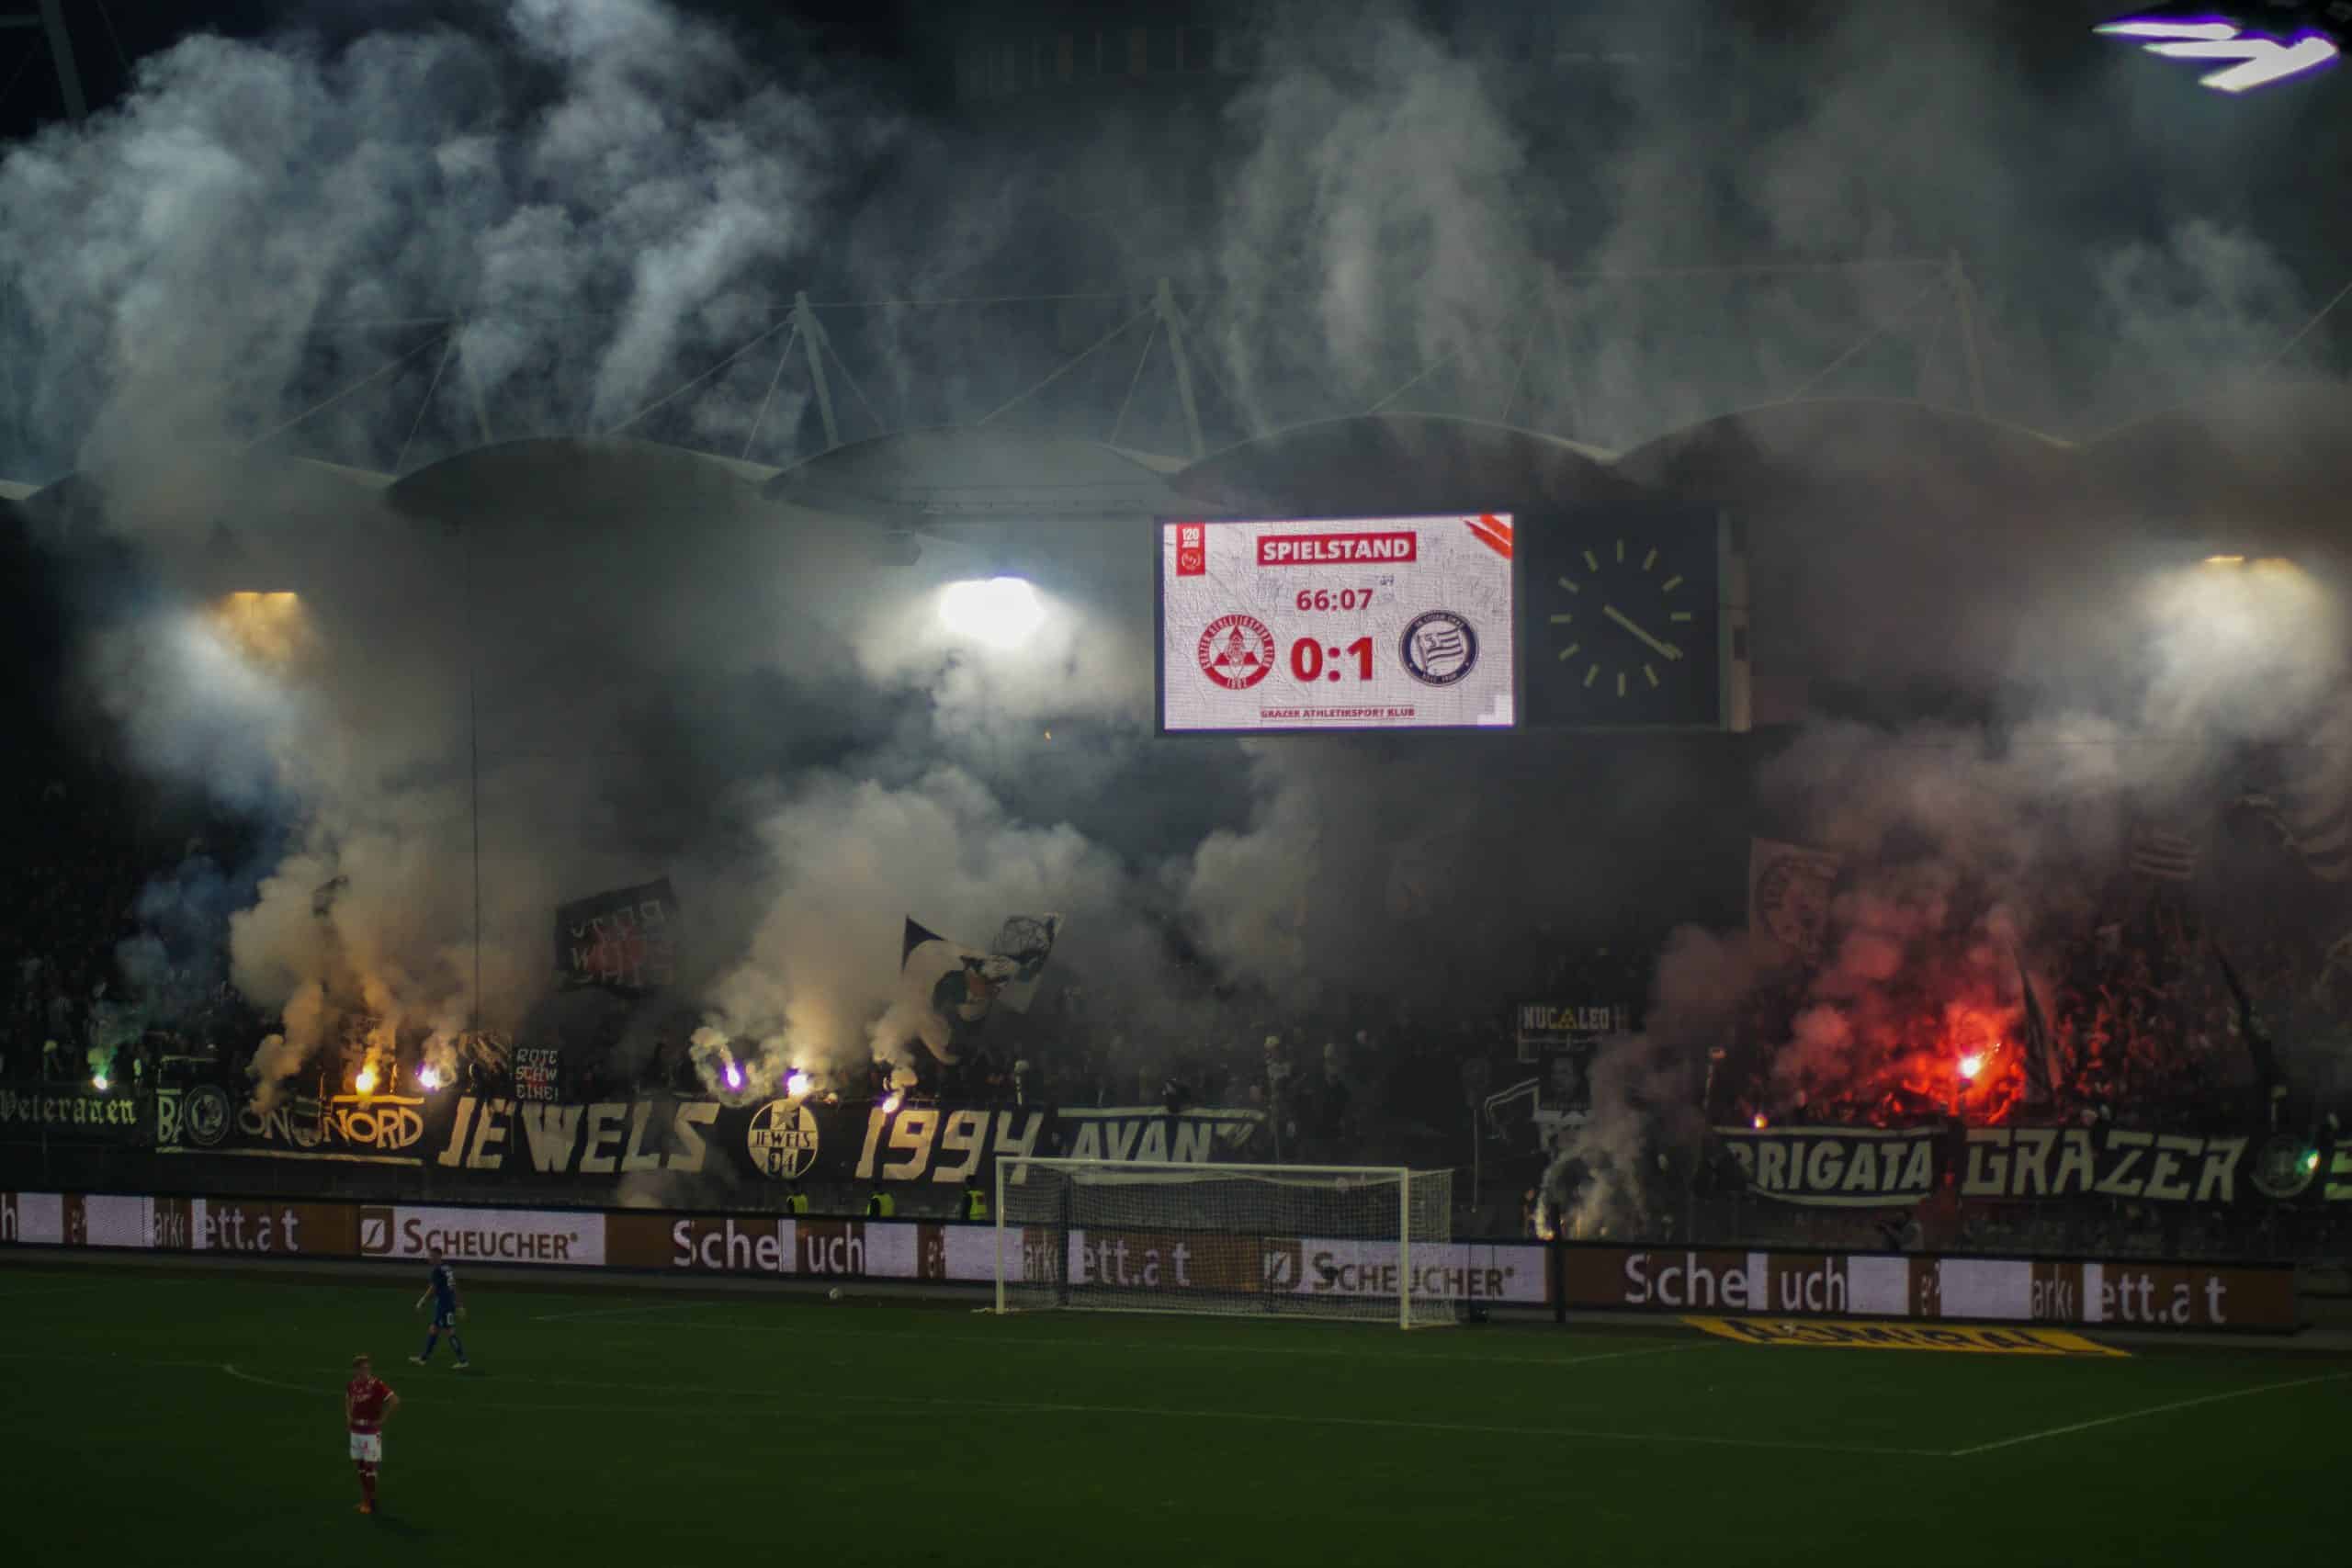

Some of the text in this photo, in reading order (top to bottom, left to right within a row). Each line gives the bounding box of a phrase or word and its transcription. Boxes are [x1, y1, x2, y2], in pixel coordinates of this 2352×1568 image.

[1263, 538, 1410, 561] SPIELSTAND
[1296, 588, 1374, 612] 66:07
[1290, 637, 1374, 682] 0:1
[1261, 707, 1416, 718] GRAZER ATHLETIKSPORT KLUB
[516, 1048, 559, 1065] ROTE
[323, 1105, 424, 1150] NORD
[437, 1096, 721, 1173] JEWELS
[755, 1131, 810, 1147] JEWELS
[854, 1107, 1045, 1184] 1994
[768, 1152, 797, 1175] 94
[1725, 1140, 1933, 1191] BRIGATA
[1961, 1127, 2250, 1202] GRAZER
